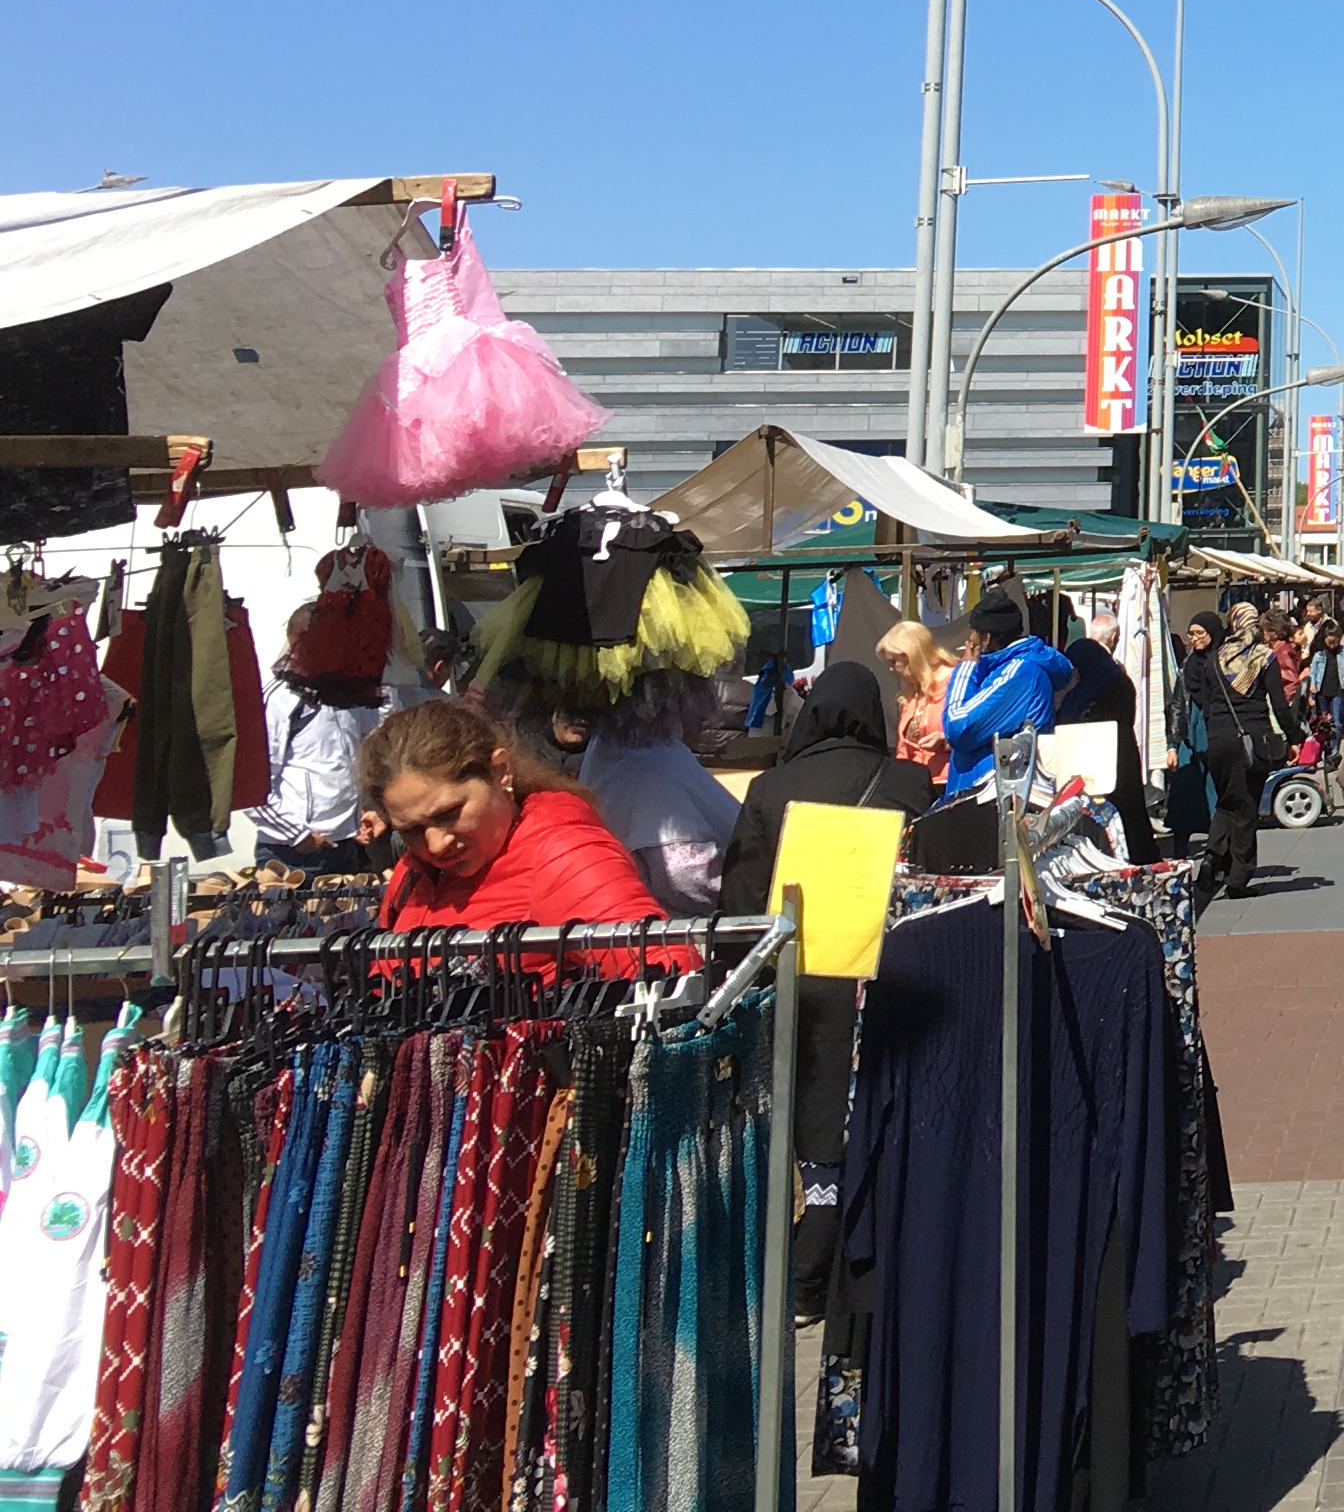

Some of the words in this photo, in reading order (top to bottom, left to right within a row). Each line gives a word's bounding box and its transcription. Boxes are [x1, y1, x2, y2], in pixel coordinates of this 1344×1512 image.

[1093, 208, 1151, 221] MARKT
[798, 330, 879, 354] ACTION
[1096, 236, 1144, 432] MARKT
